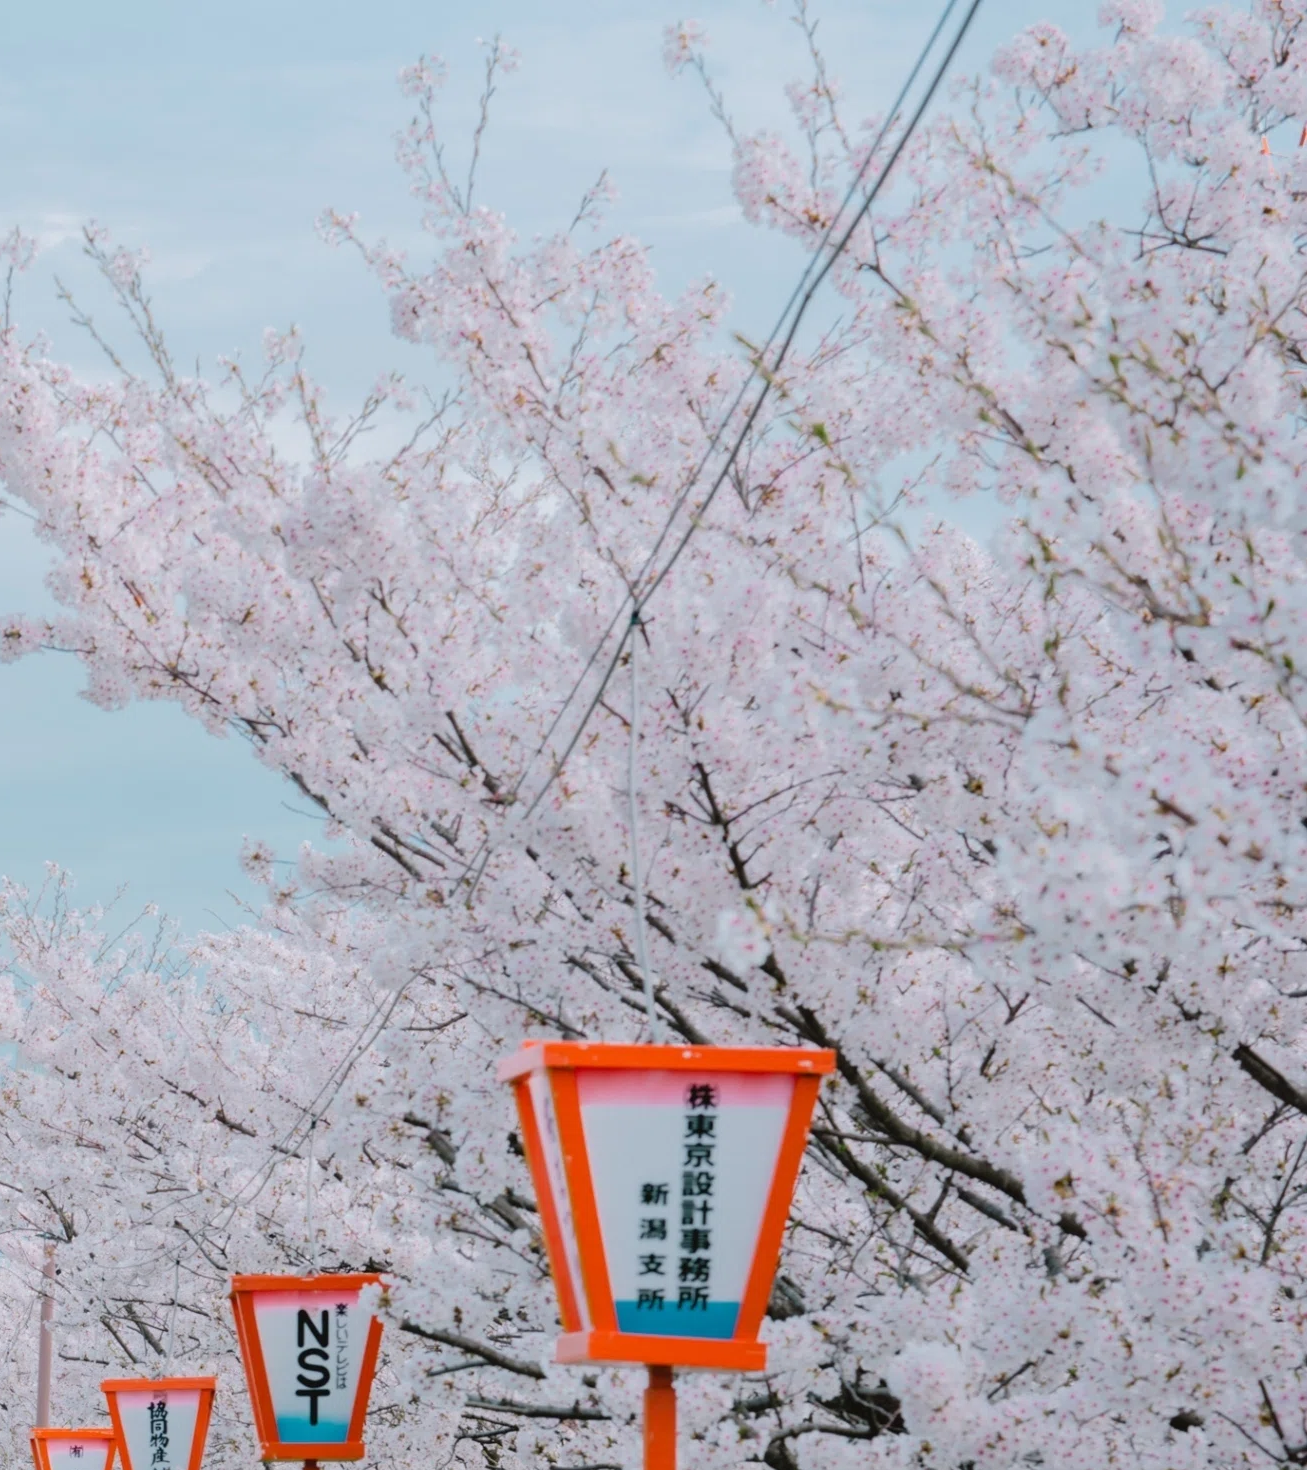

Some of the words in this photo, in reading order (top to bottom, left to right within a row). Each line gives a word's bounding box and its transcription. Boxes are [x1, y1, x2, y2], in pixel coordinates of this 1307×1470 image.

[637, 1182, 670, 1312] 新潟支所
[295, 1309, 331, 1426] NST
